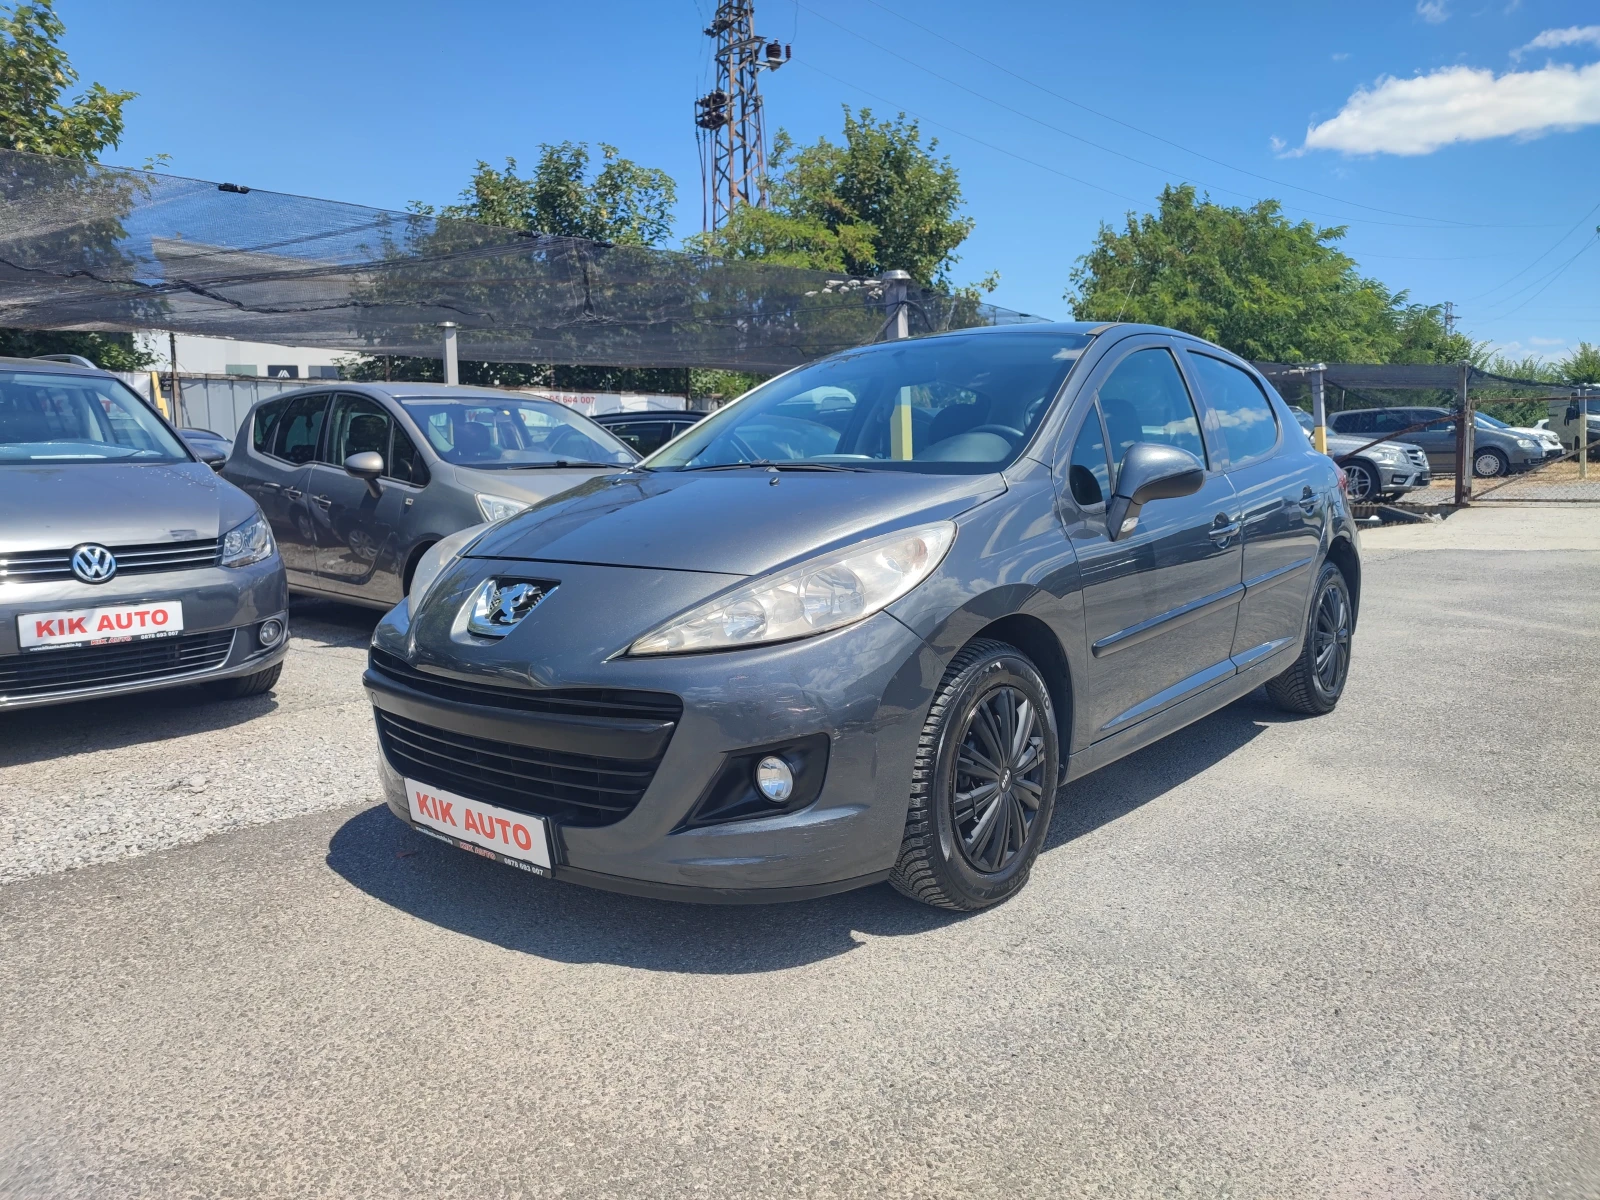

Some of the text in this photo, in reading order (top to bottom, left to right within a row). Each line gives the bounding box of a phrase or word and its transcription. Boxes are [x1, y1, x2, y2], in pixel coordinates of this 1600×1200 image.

[562, 395, 578, 404] 644
[580, 396, 596, 404] 007
[36, 608, 170, 638] KIK AUTO
[415, 791, 532, 851] KIK AUTO
[531, 867, 544, 876] 007
